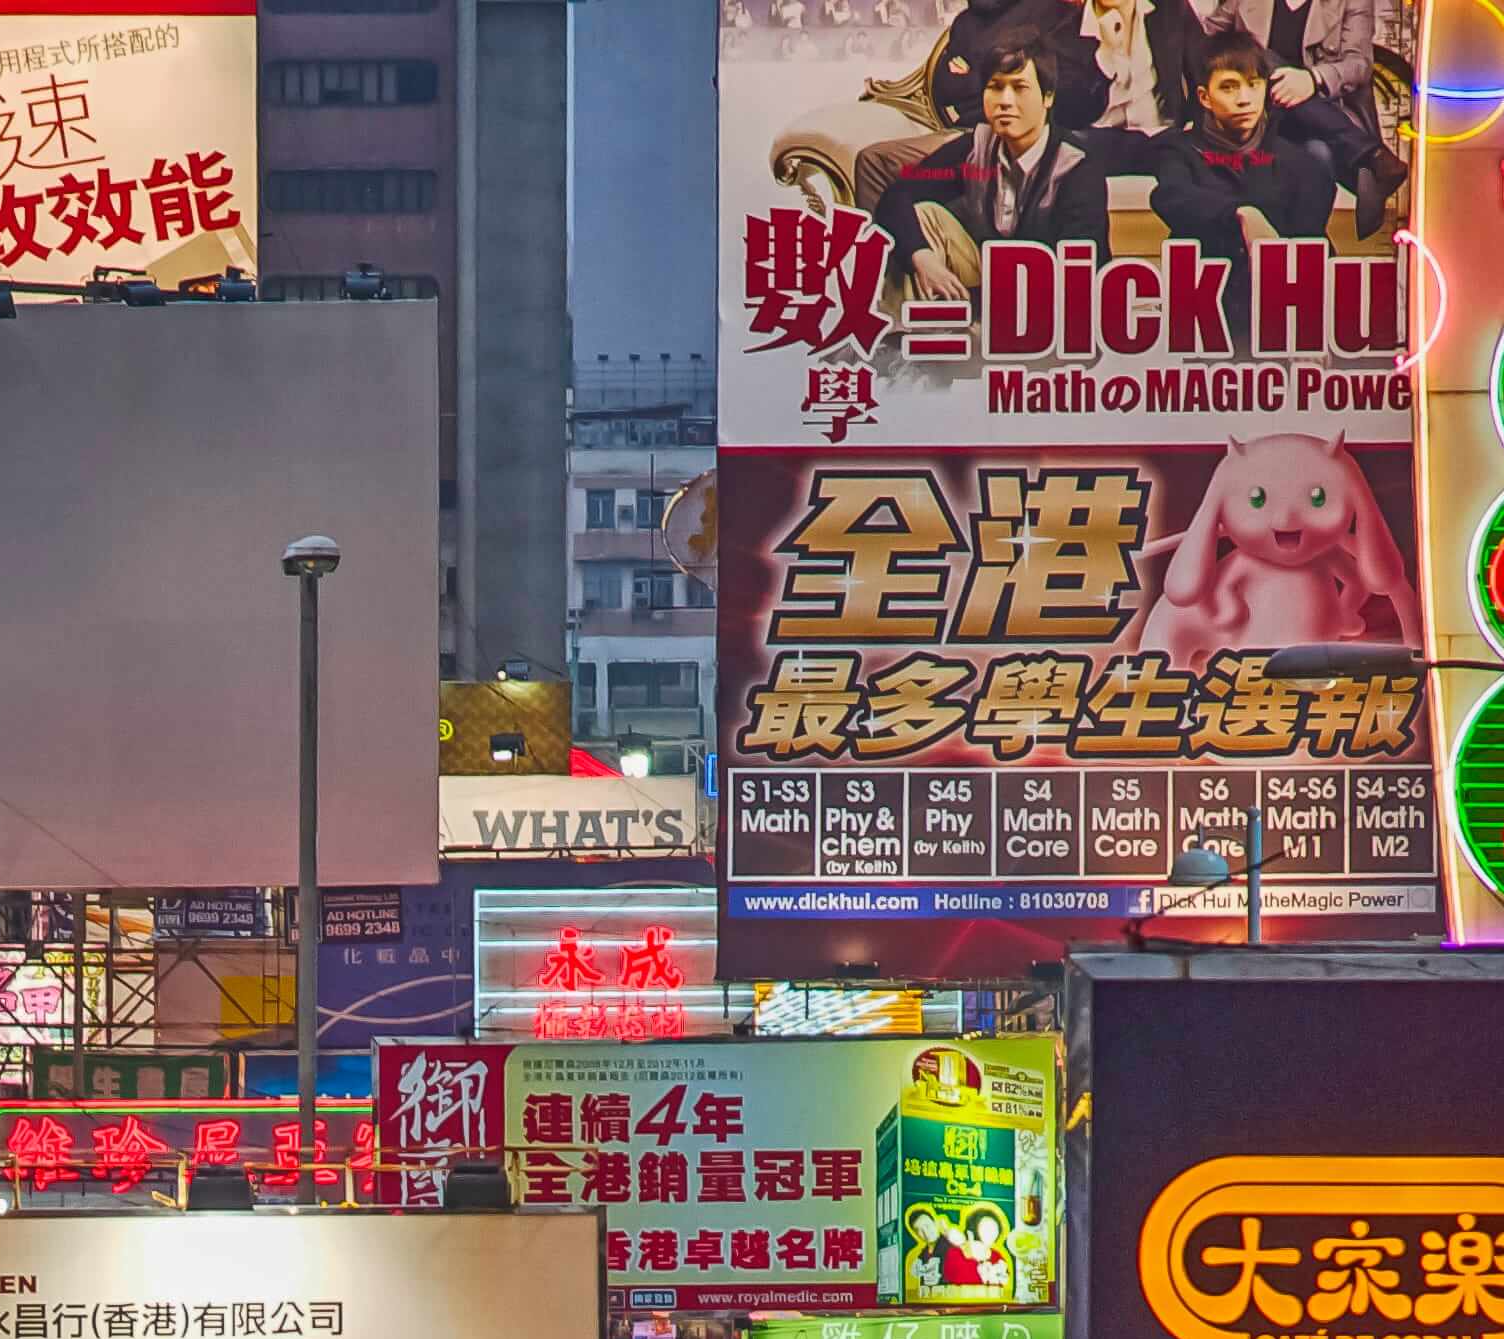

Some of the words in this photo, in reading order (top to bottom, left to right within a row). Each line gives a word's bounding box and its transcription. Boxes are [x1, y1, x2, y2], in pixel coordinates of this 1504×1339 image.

[742, 207, 894, 360] 數
[982, 240, 1232, 360] Dick
[771, 467, 1152, 644] 全港
[845, 779, 876, 803] S3
[927, 779, 973, 804] S45
[1022, 779, 1054, 803] S4
[1110, 779, 1142, 803] S5
[1198, 779, 1230, 803] S6
[473, 808, 685, 848] WHAT'S
[740, 806, 810, 834] Math
[924, 807, 974, 838] Phy
[1002, 807, 1072, 834] Math
[1090, 807, 1161, 834] Math
[1266, 805, 1336, 831] Math
[1355, 804, 1426, 831] Math
[821, 832, 902, 857] chem
[1005, 835, 1070, 859] Core
[1094, 835, 1159, 859] Core
[1371, 834, 1410, 858] M2
[934, 892, 1003, 910] Hotline
[1018, 891, 1110, 911] 81030708
[522, 1085, 745, 1146] 連續4年
